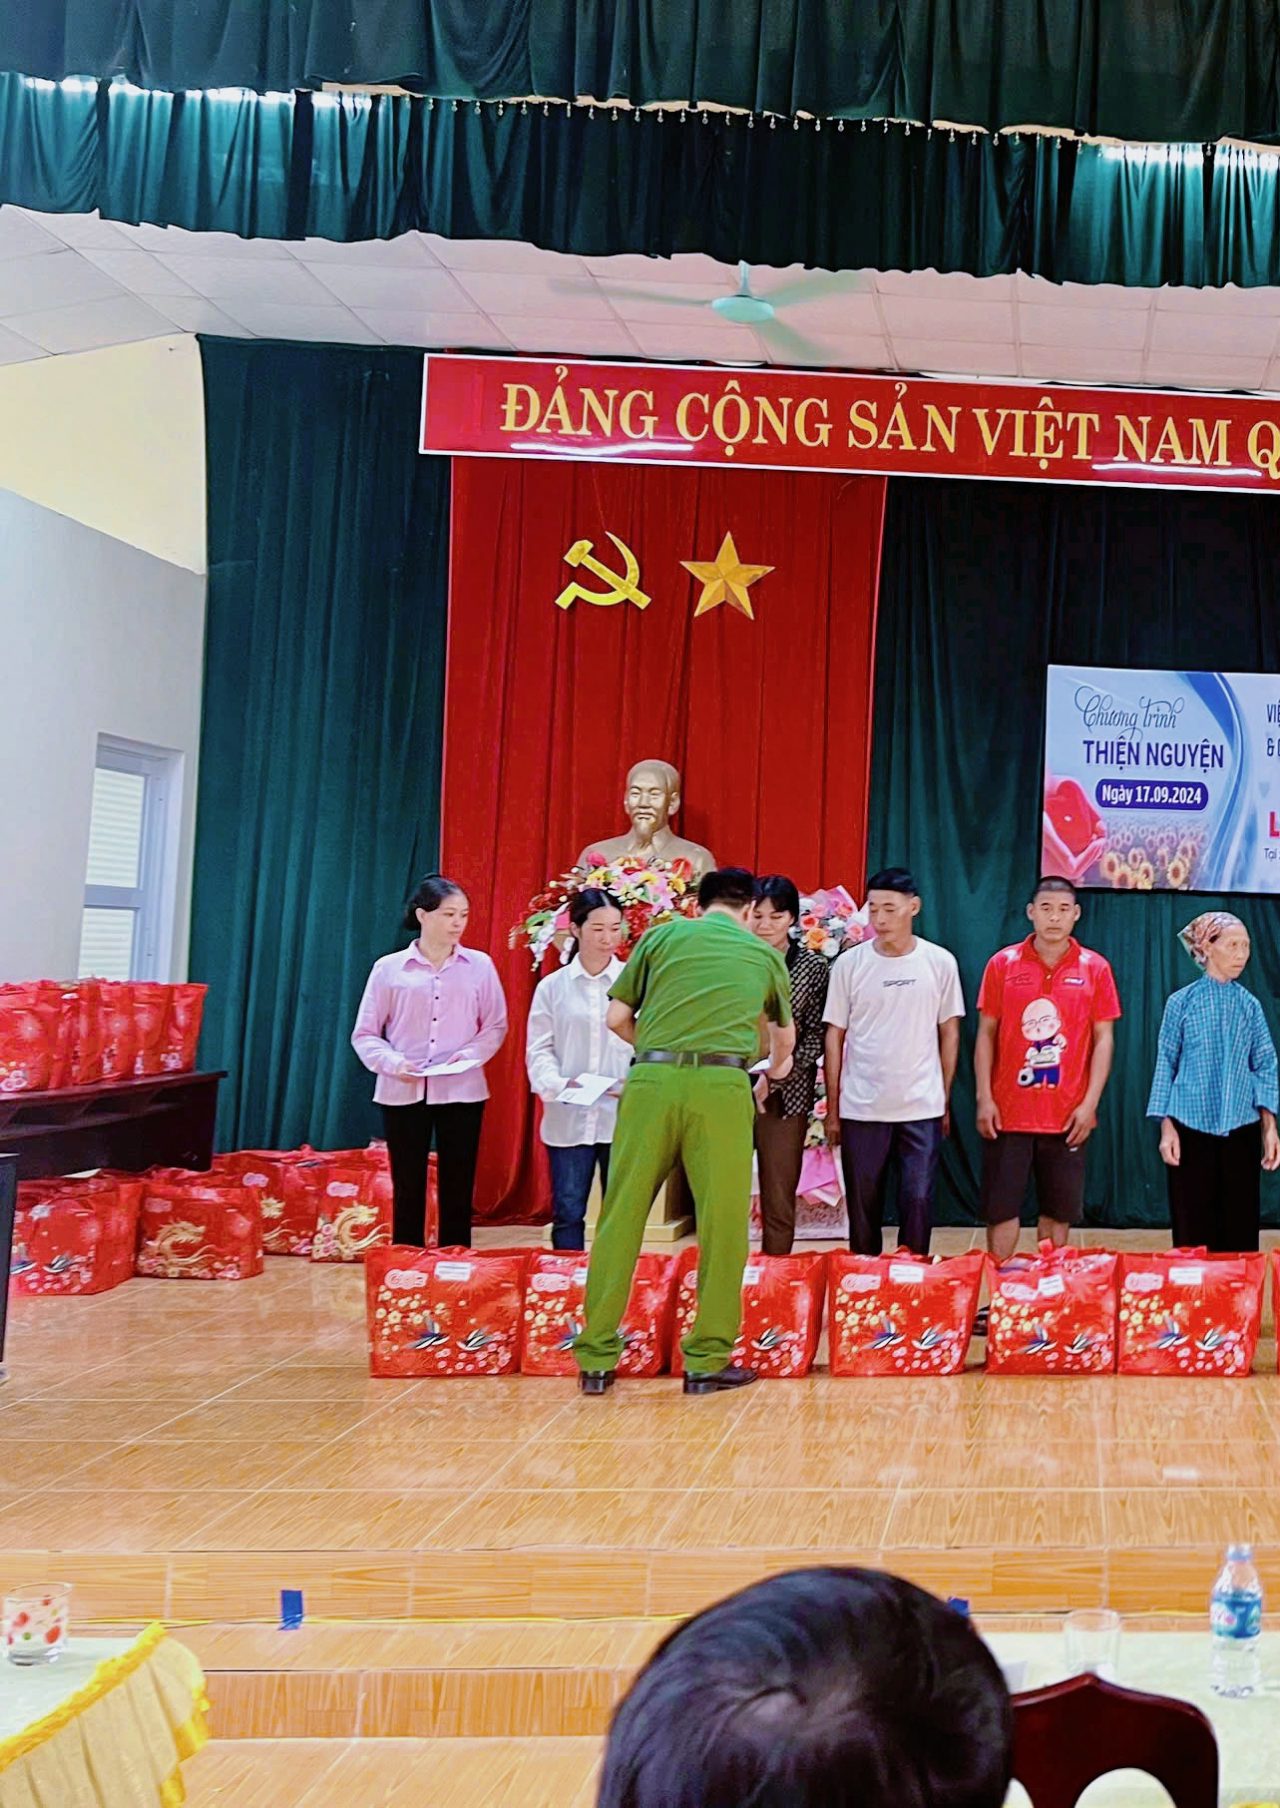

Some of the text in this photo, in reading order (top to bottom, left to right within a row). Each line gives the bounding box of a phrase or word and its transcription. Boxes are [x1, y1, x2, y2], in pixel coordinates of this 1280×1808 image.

[501, 365, 658, 440] ĐẢNG
[676, 379, 833, 457] CỘNG
[848, 382, 961, 453] SẢN
[972, 396, 1100, 470] VIỆT
[1114, 415, 1232, 467] NAM
[1075, 686, 1143, 742] Chương
[1083, 736, 1224, 773] THIỆN NGUYỆN
[1267, 737, 1275, 757] &
[1102, 785, 1202, 804] Ngày 17.09.2024
[1264, 848, 1277, 862] Tại
